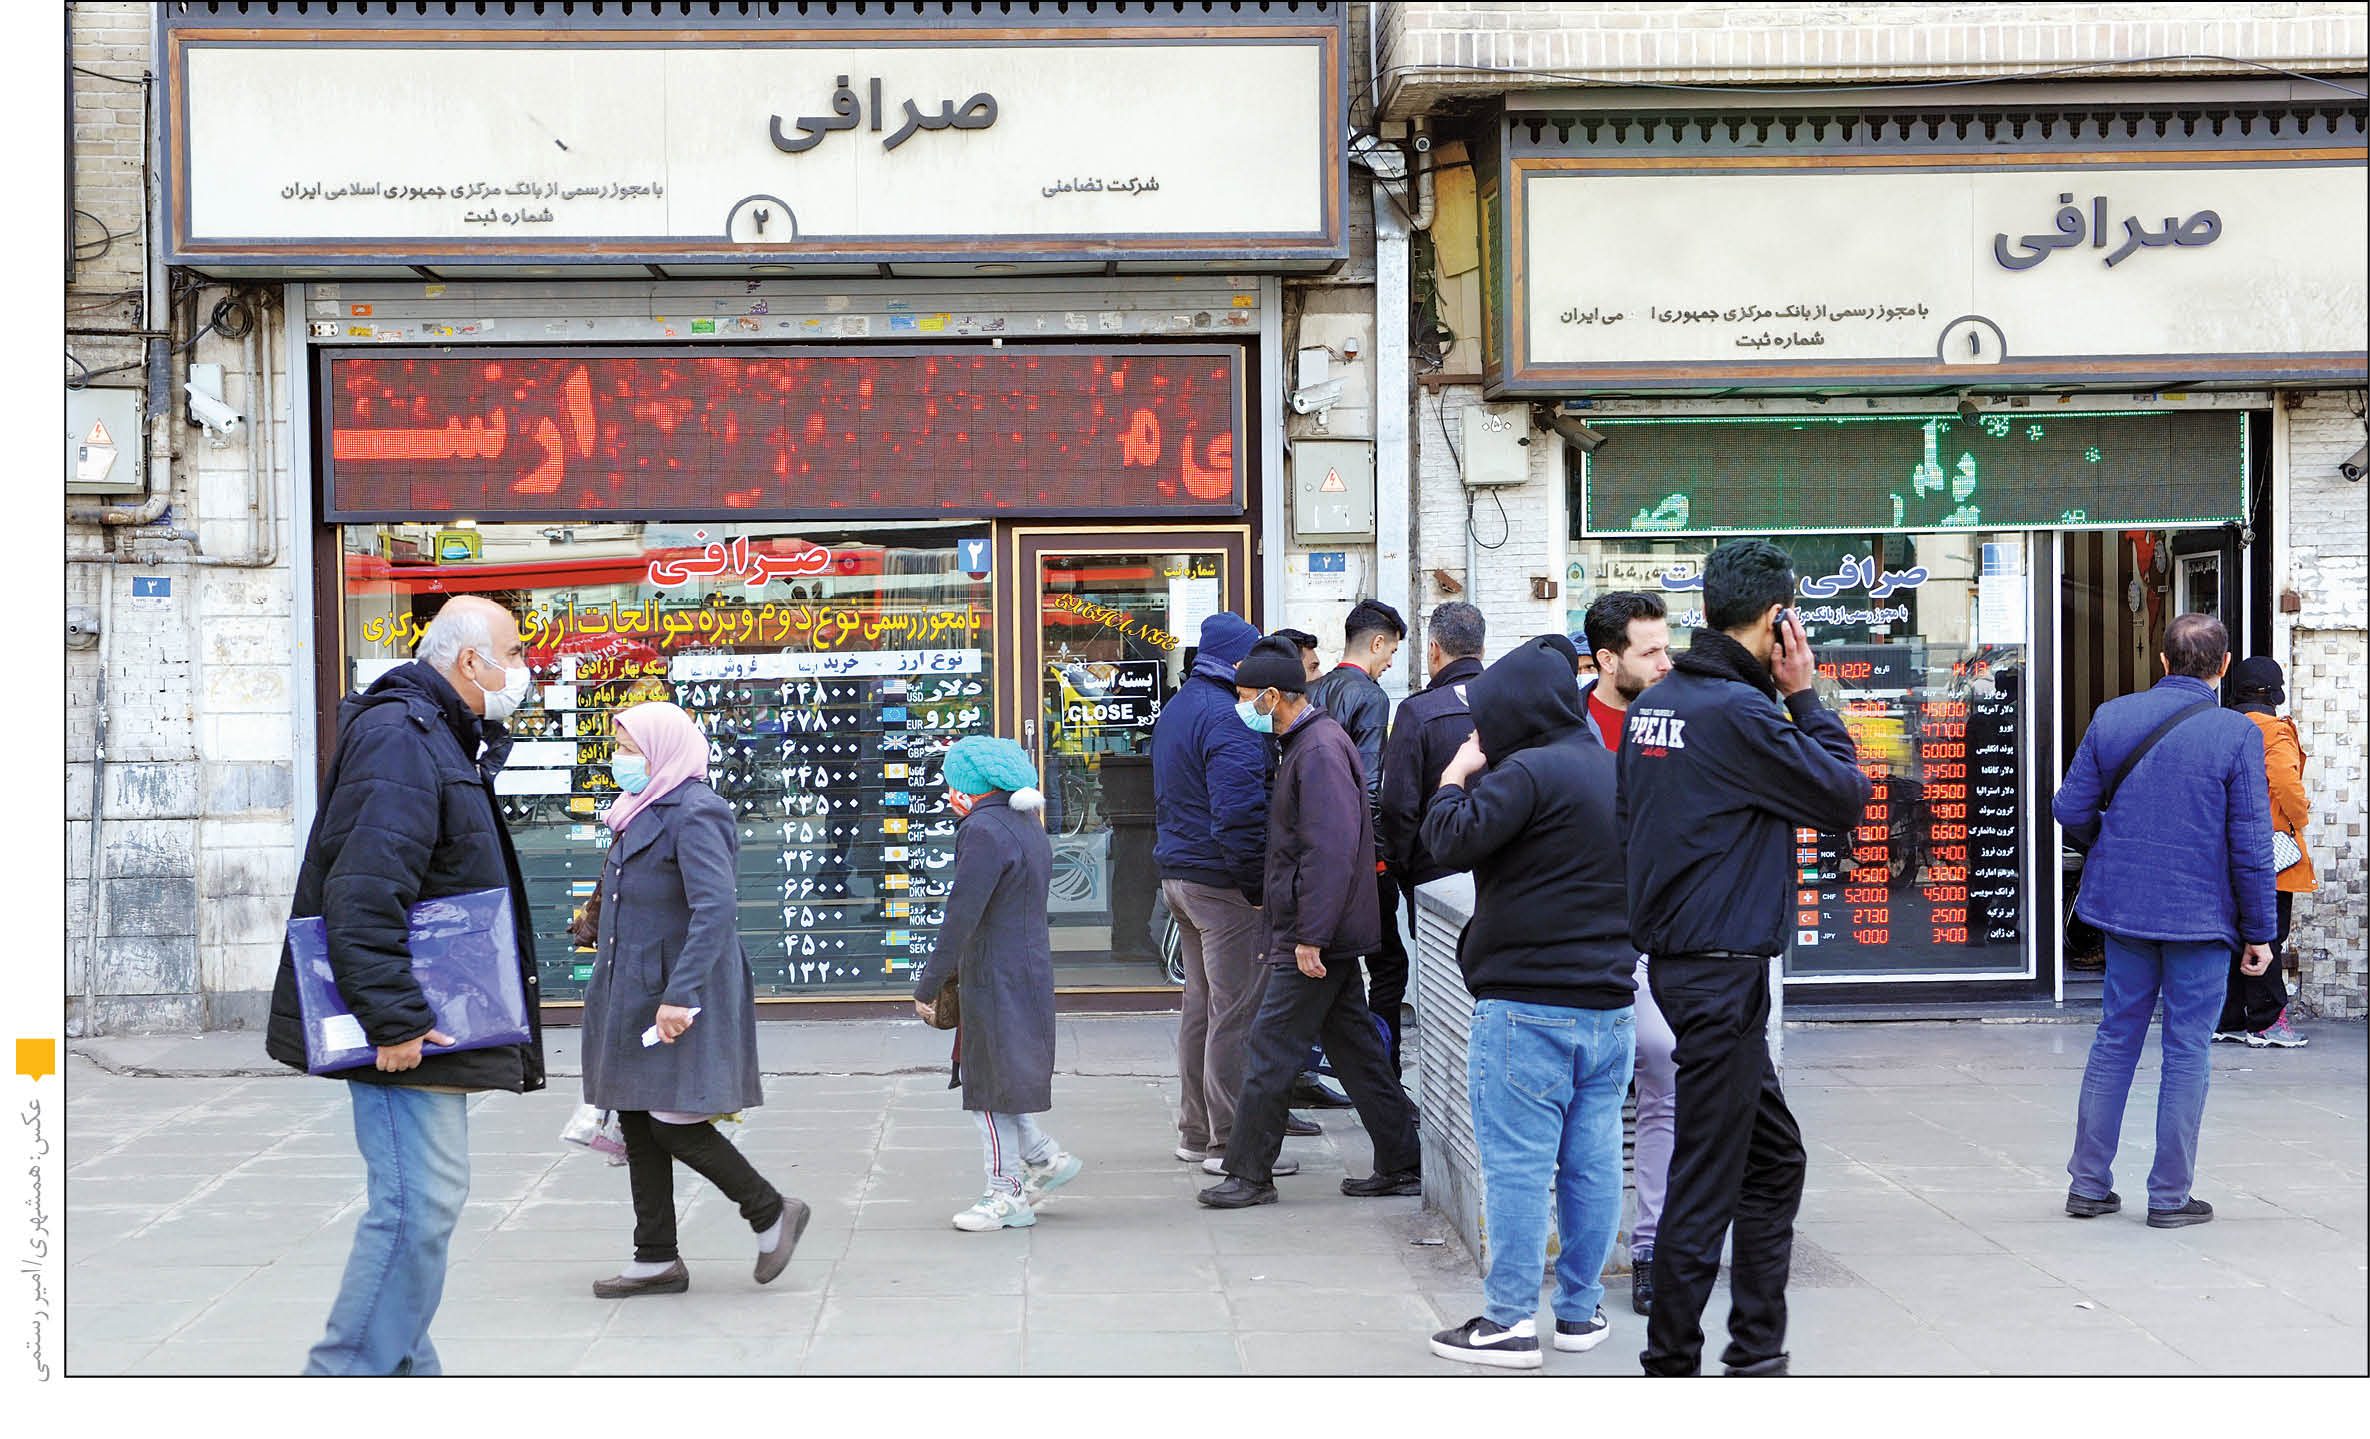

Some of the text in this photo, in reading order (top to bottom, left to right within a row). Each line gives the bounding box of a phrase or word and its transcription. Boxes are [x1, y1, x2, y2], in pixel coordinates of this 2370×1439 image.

[769, 73, 999, 154] صرافی
[280, 181, 322, 201] ایران
[324, 181, 380, 201] اسلامی
[383, 183, 447, 202] جمهوری
[450, 182, 501, 201] مرکزی
[505, 182, 543, 199] بانک
[561, 184, 607, 201] رسمی
[610, 182, 650, 200] مجوز
[1041, 177, 1160, 199] شرکت تضامنی
[463, 207, 554, 224] شماره ثبت
[752, 207, 769, 235] ۲
[1994, 192, 2223, 272] صرافی
[1560, 308, 1599, 324] ایران
[1658, 307, 1719, 325] جمهوری
[1723, 305, 1772, 323] مرکزی
[1774, 304, 1812, 321] بانک
[1812, 304, 1827, 322] از
[1829, 305, 1875, 323] رسمی
[1874, 304, 1916, 323] مجوز
[1916, 303, 1929, 317] با
[1735, 330, 1825, 348] شماره ثبت
[647, 529, 832, 589] صرافی
[967, 541, 984, 570] ۲
[1163, 563, 1216, 580] شماره ثبت
[1799, 553, 1930, 599] صرافی
[698, 591, 753, 645] ویژه
[757, 602, 813, 642] دوم
[812, 597, 860, 649] نوع
[920, 605, 967, 642] مجوز
[967, 602, 981, 640] با
[1811, 603, 1909, 625] با مجوز رسمی از بانک
[516, 600, 574, 649] ارزی
[864, 604, 920, 648] رسمی
[576, 656, 616, 681] آزادی
[618, 658, 641, 681] بهار
[642, 658, 668, 680] سکه
[717, 655, 759, 678] فروش
[823, 653, 859, 674] خرید
[897, 651, 963, 672] نوع ارز
[1083, 668, 1117, 689] است
[1118, 671, 1153, 692] بسته
[593, 685, 616, 707] امام
[674, 683, 752, 708] ۴۵۲۰۰
[779, 681, 857, 705] ۴۴۸۰۰
[906, 692, 924, 703] USD
[923, 678, 982, 703] دلار
[923, 705, 982, 730] یورو
[1068, 703, 1134, 723] CLOSE
[1921, 702, 1966, 718] 45000
[779, 709, 857, 733] ۴۷۸۰۰
[906, 719, 924, 730] EUR
[1921, 723, 1966, 738] 47700
[781, 739, 858, 762] ۶۰۰۰۰
[907, 748, 925, 759] GBP
[1921, 743, 1966, 759] 60000
[781, 764, 858, 790] ۳۴۵۰۰
[1923, 763, 1967, 780] 34500
[907, 776, 926, 788] CAD
[1922, 784, 1967, 801] 33500
[781, 794, 860, 817] ۳۳۵۰۰
[908, 804, 926, 814] AUD
[1930, 803, 1967, 819] 4300
[782, 821, 860, 844] ۴۵۰۰۰
[907, 831, 925, 842] CHF
[782, 849, 844, 873] ۳۴۰۰
[1931, 845, 1967, 861] 4400
[908, 858, 926, 870] JPY
[1849, 867, 1889, 883] 14500
[1927, 866, 1967, 882] 13200
[784, 877, 844, 900] ۶۶۰۰
[909, 886, 926, 898] DKK
[1844, 887, 1889, 904] 52000
[1923, 886, 1967, 903] 45000
[783, 904, 844, 928] ۴۵۰۰
[909, 915, 927, 926] NOK
[1853, 907, 1889, 924] 2730
[1821, 932, 1837, 940] JPY
[1852, 928, 1889, 945] 4000
[1931, 926, 1968, 944] 3400
[784, 933, 845, 958] ۴۵۰۰
[909, 943, 927, 954] SEK
[788, 960, 861, 984] ۱۳۲۰۰
[909, 970, 922, 982] AE
